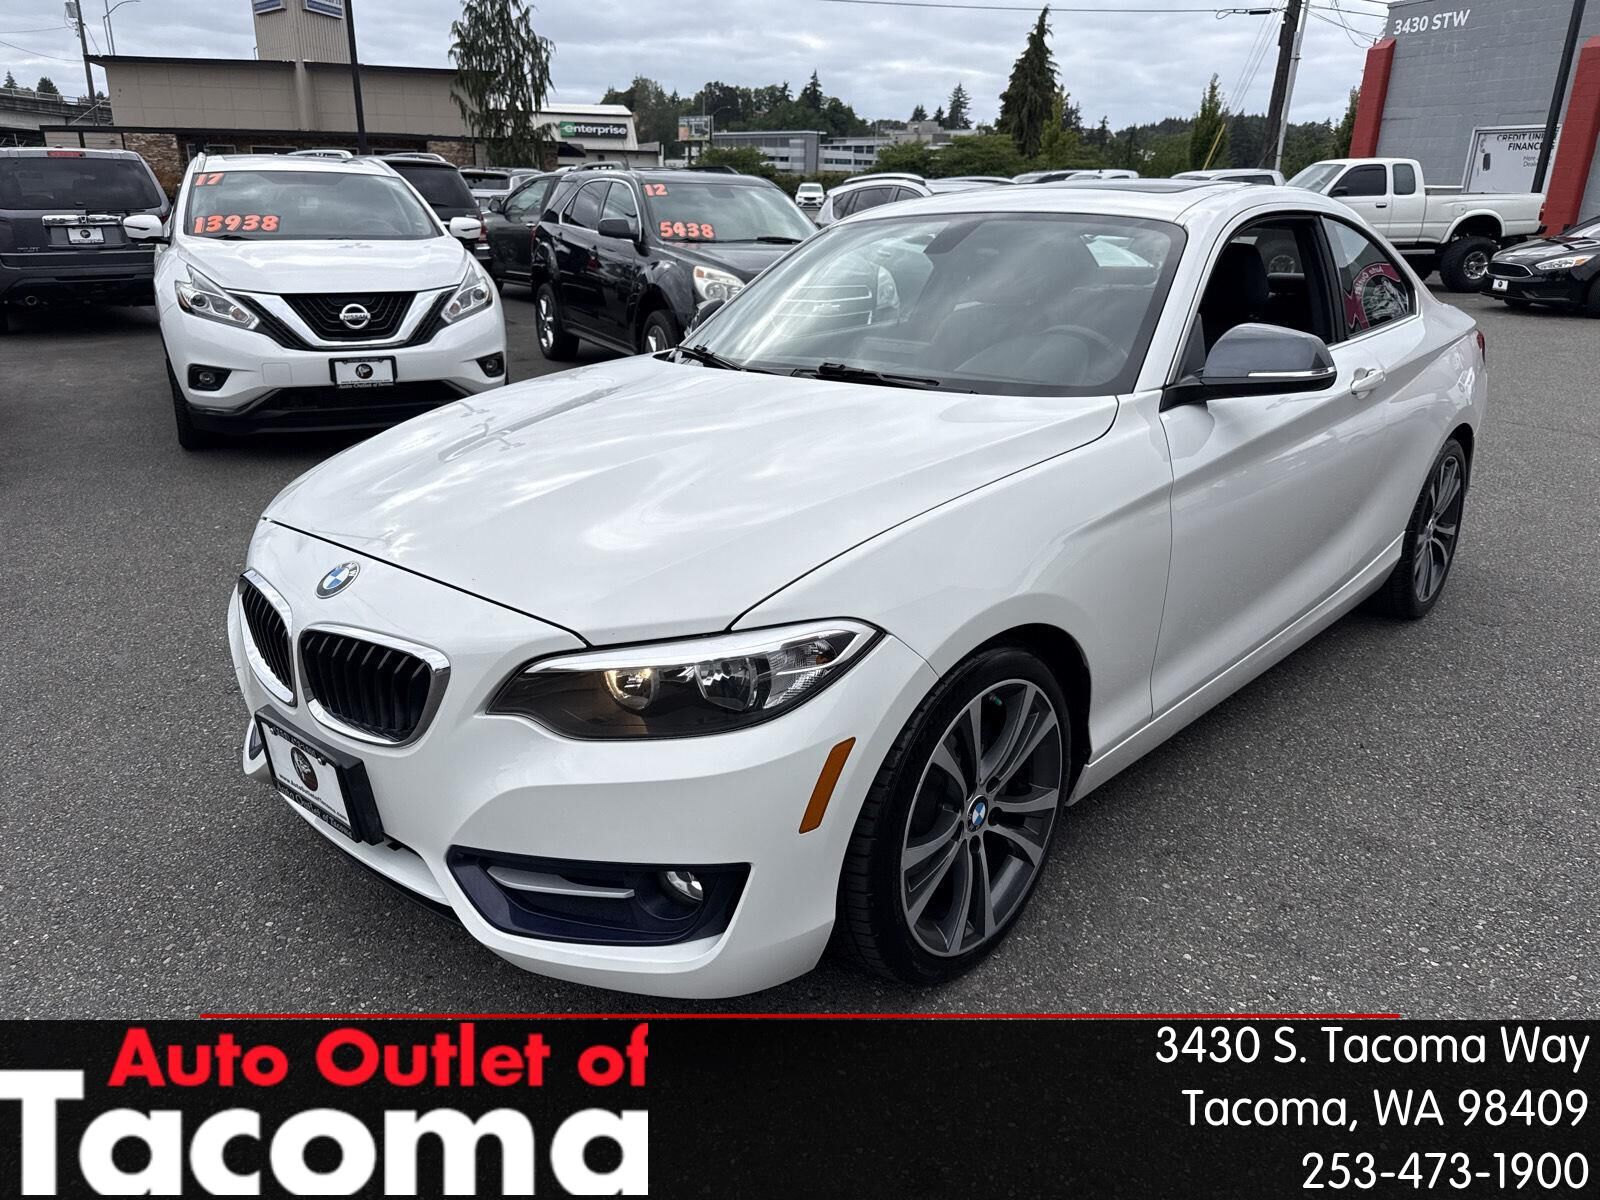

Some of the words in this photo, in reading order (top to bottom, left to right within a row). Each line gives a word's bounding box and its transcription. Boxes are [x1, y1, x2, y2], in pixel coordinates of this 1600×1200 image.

[1393, 16, 1429, 35] 3430
[1431, 9, 1471, 30] STW
[563, 124, 627, 135] enterprise
[195, 173, 224, 186] 17
[645, 184, 668, 196] 12
[194, 215, 279, 233] 13938
